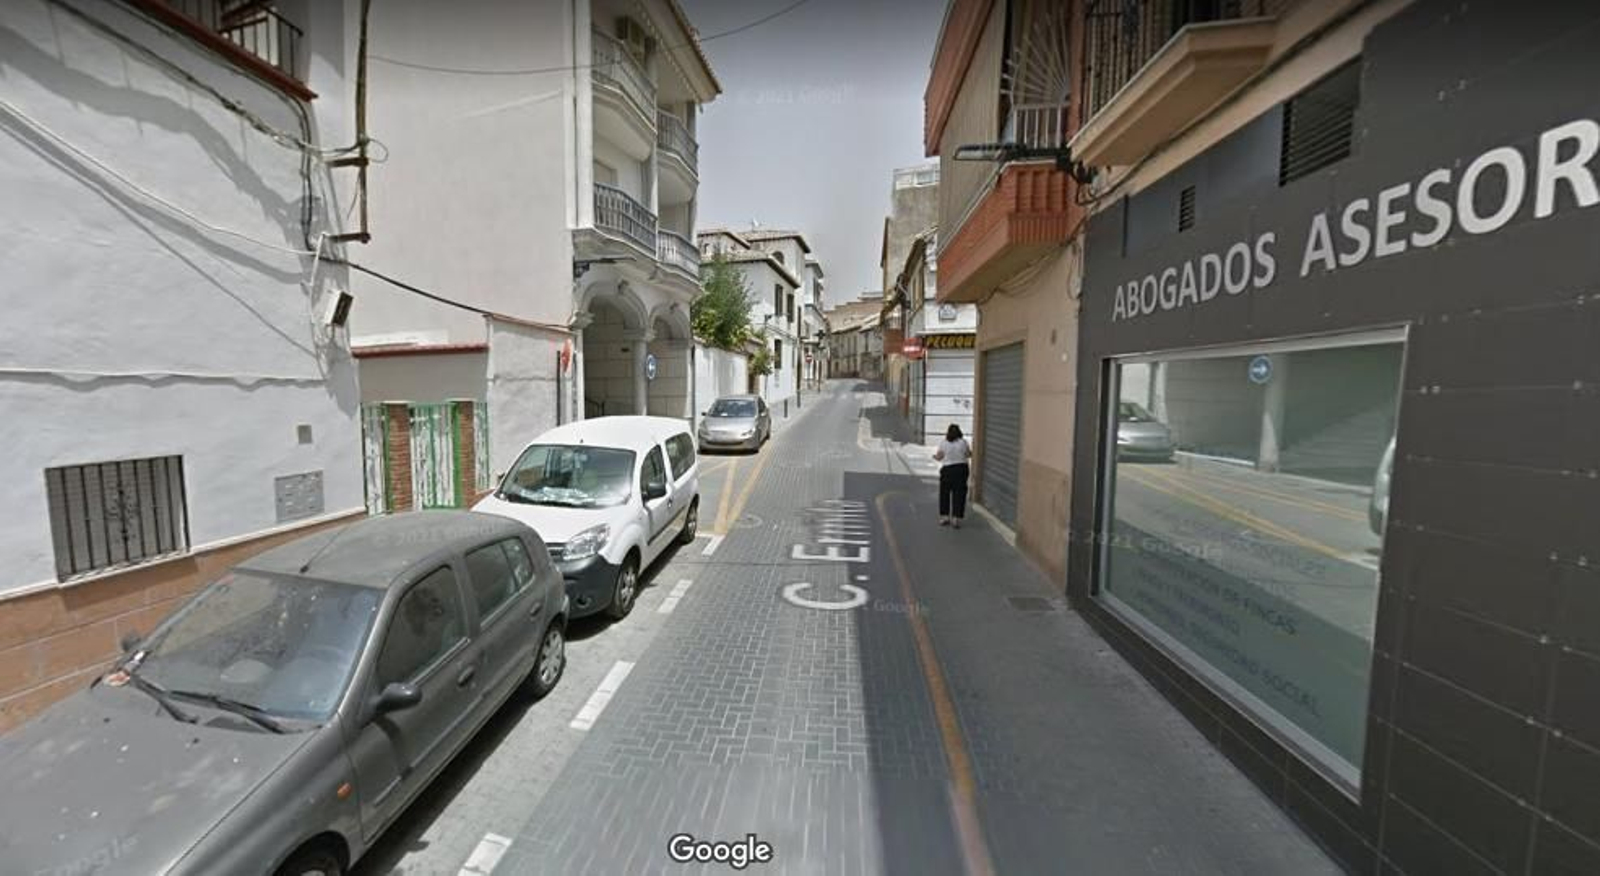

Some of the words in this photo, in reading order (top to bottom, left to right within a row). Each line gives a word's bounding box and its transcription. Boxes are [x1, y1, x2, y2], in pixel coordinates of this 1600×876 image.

[1112, 232, 1276, 322] ABOGADOS
[1300, 118, 1600, 278] ASESOR
[782, 575, 869, 610] C.
